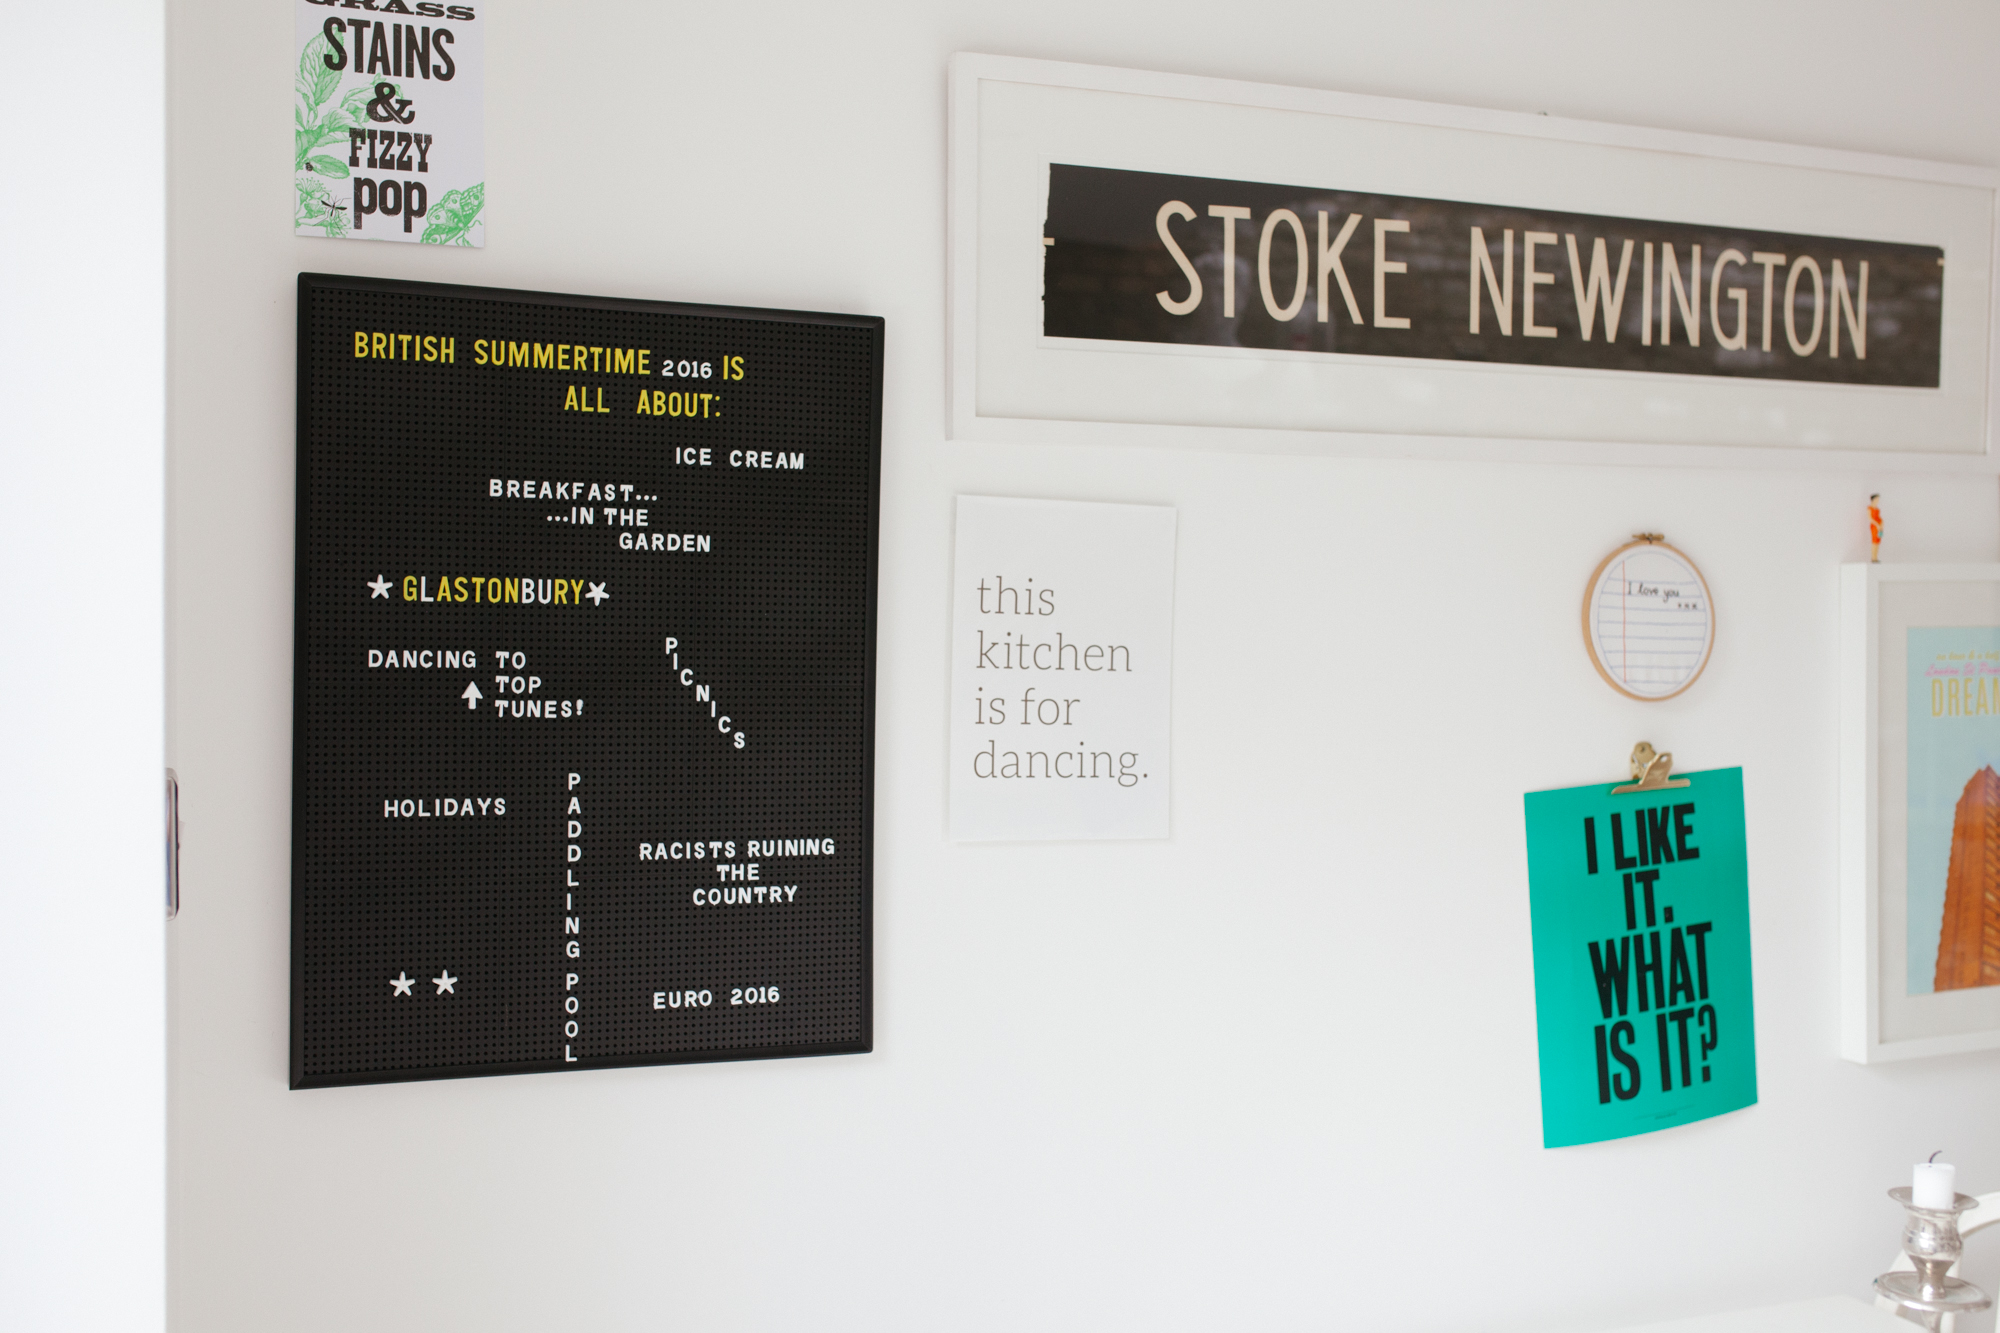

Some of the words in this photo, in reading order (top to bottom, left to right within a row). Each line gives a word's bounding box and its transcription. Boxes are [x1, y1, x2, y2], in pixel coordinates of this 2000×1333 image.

[323, 16, 456, 82] STAINS
[366, 82, 415, 124] &
[349, 128, 432, 172] FIZZY
[354, 177, 427, 233] pop
[1154, 199, 1411, 330] STOKE
[1468, 225, 1869, 360] NEWINGTON
[355, 332, 454, 363] BRITISH
[474, 339, 650, 374] SUMMERTIME
[662, 360, 712, 379] 2016
[724, 356, 744, 380] IS
[564, 386, 610, 412] ALL
[637, 390, 720, 418] ABOUT:
[676, 447, 711, 465] ICE
[730, 450, 804, 469] CREAM
[490, 479, 657, 501] BREAKFAST...
[604, 508, 648, 526] THE
[619, 533, 710, 552] GARDEN
[404, 576, 584, 604] GLASTONBURY
[977, 576, 1054, 616] this
[1637, 581, 1660, 597] love
[1662, 588, 1680, 604] you
[368, 650, 476, 668] DANCING
[496, 651, 526, 669] TO
[977, 630, 1132, 671] kitchen
[496, 676, 541, 694] TOP
[666, 637, 745, 749] PICNICS
[495, 699, 583, 718] TUNES!
[976, 687, 1005, 724] is
[1021, 688, 1080, 725] for
[974, 740, 1147, 787] dancing.
[384, 798, 505, 817] HOLIDAYS
[639, 841, 735, 860] RACISTS
[748, 838, 834, 858] RUINING
[1584, 817, 1598, 874] I
[1610, 802, 1701, 871] LIKE
[566, 773, 581, 958] PADDLING
[717, 864, 759, 881] THE
[693, 885, 797, 906] COUNTRY
[1622, 868, 1674, 930] IT.
[1588, 921, 1712, 1019] WHAT
[565, 973, 578, 1062] POOL
[653, 990, 712, 1010] EURO
[730, 986, 779, 1005] 2016
[1594, 1020, 1641, 1105] IS
[1656, 1004, 1718, 1092] IT?
